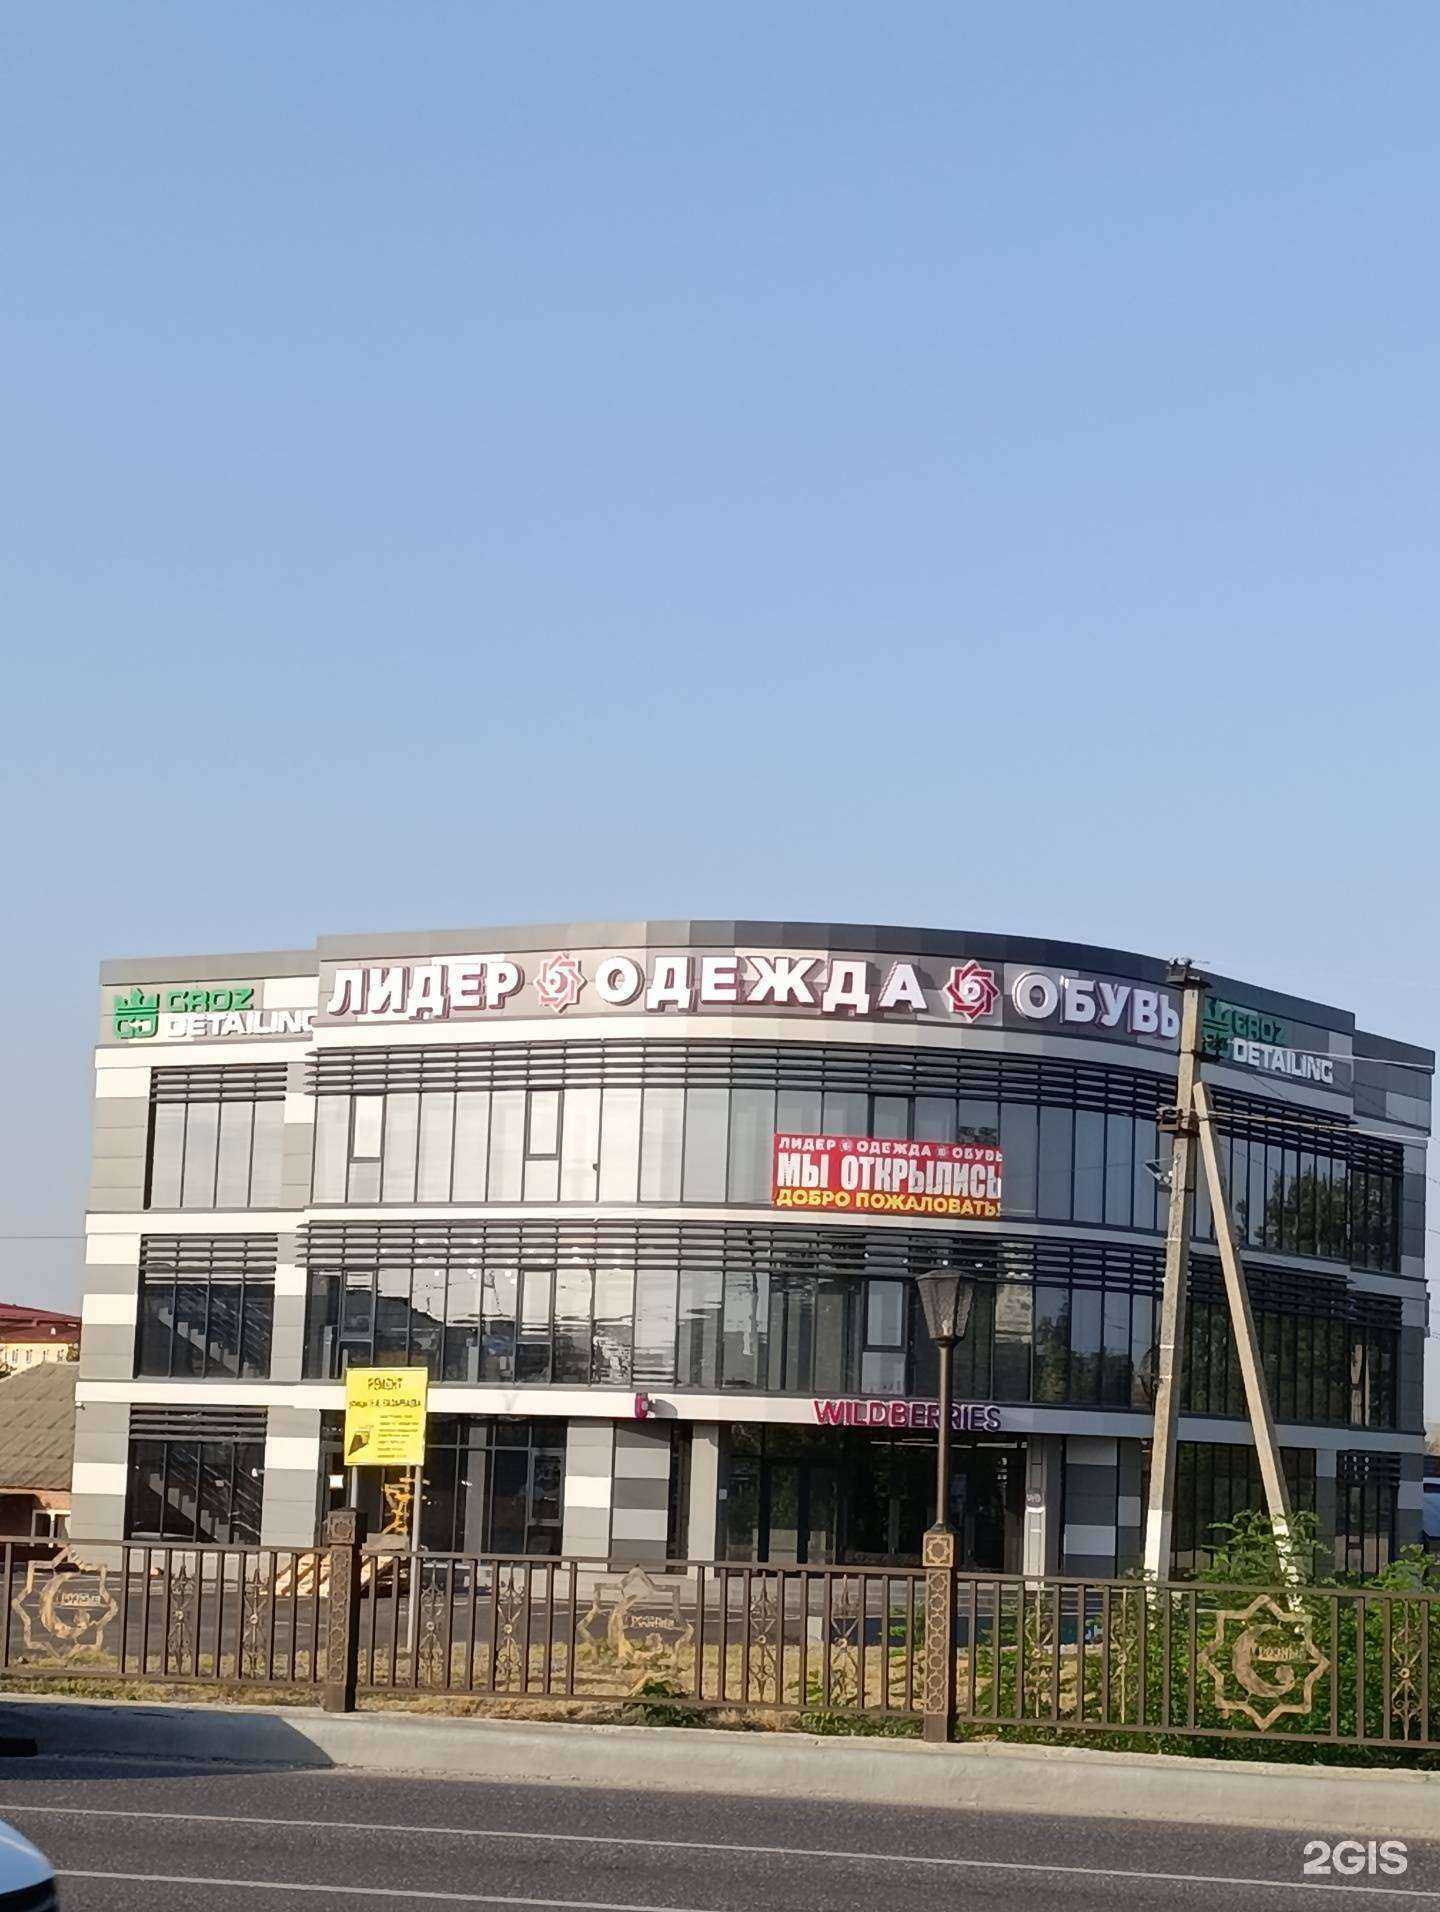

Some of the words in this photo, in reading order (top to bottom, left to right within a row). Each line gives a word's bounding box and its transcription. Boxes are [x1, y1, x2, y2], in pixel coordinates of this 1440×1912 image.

[168, 988, 255, 1013] GROZ
[328, 961, 525, 1020] ЛИДЕР
[597, 955, 929, 1016] ОДЕЖДА
[1011, 971, 1180, 1039] ОБУВЬ
[1232, 1037, 1334, 1084] DETAILING
[778, 1137, 836, 1151] ЛИДЕР
[856, 1140, 931, 1157] ОДЕЖДА
[952, 1146, 1003, 1162] ОБУВЬ
[777, 1152, 829, 1188] МЫ
[841, 1155, 1002, 1199] ОТКРЫЛИСЬ
[776, 1189, 850, 1207] ДОБРО
[813, 1398, 1001, 1431] WILDBERRIES
